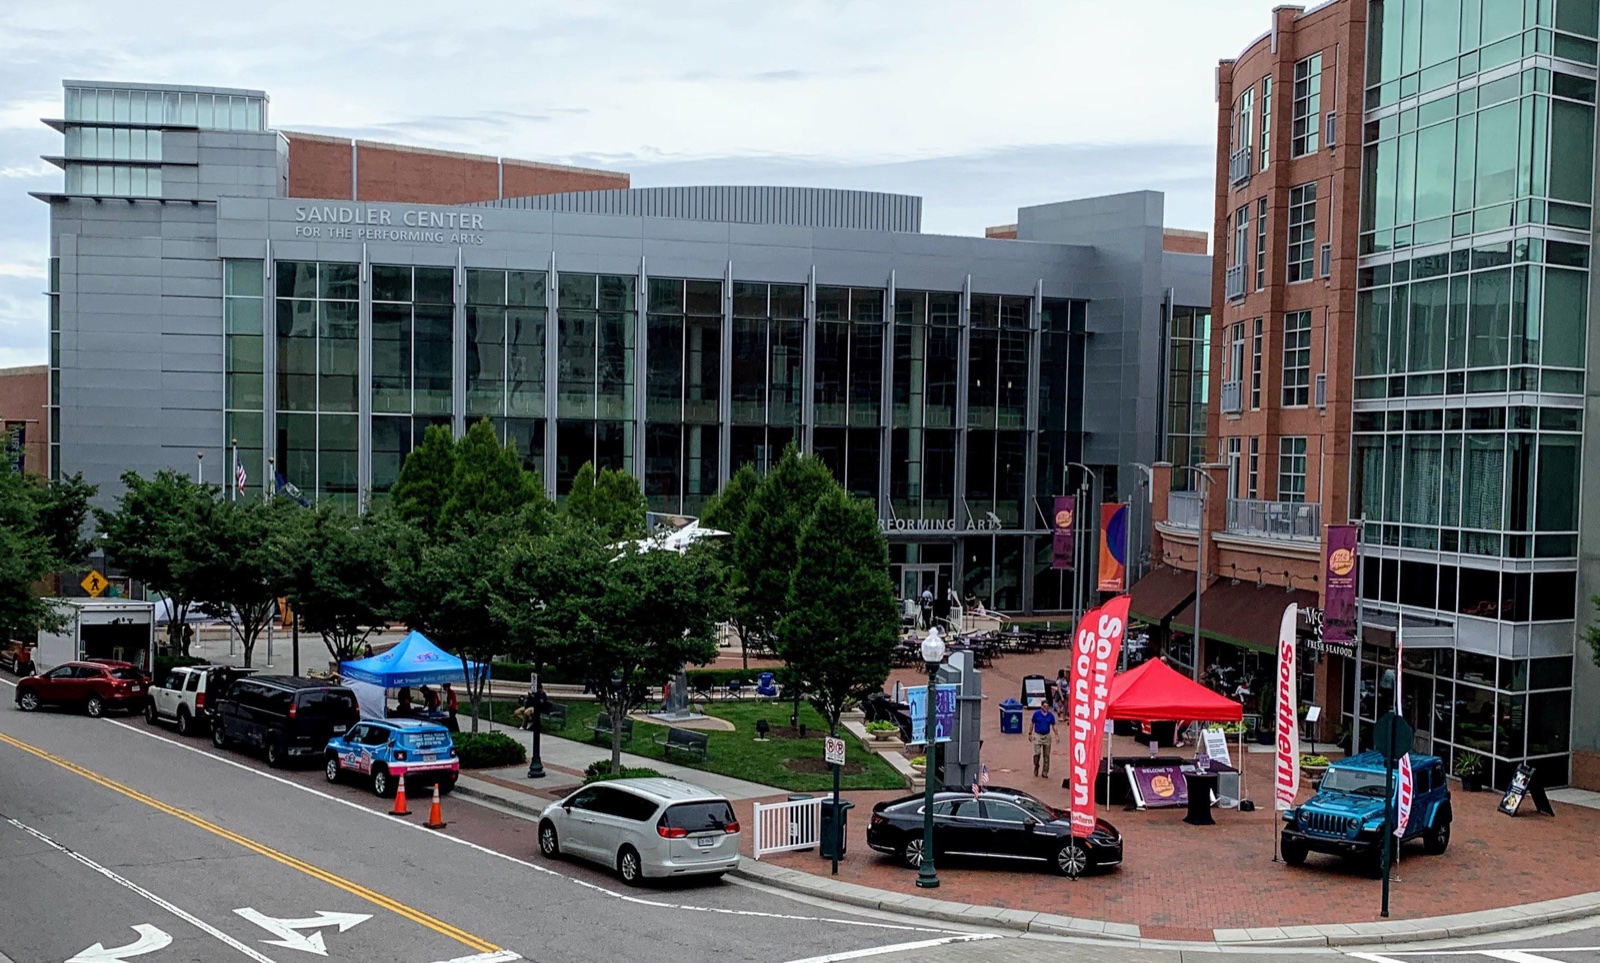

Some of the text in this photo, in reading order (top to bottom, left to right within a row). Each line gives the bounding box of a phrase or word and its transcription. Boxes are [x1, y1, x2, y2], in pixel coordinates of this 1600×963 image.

[295, 206, 484, 230] SANDLER CENTER
[295, 226, 484, 245] FOR THE PERFORMING ARTS
[877, 518, 956, 531] RFORMING
[1325, 643, 1353, 658] SEAFOOD
[1073, 628, 1096, 806] Southern
[1277, 640, 1294, 788] Southern
